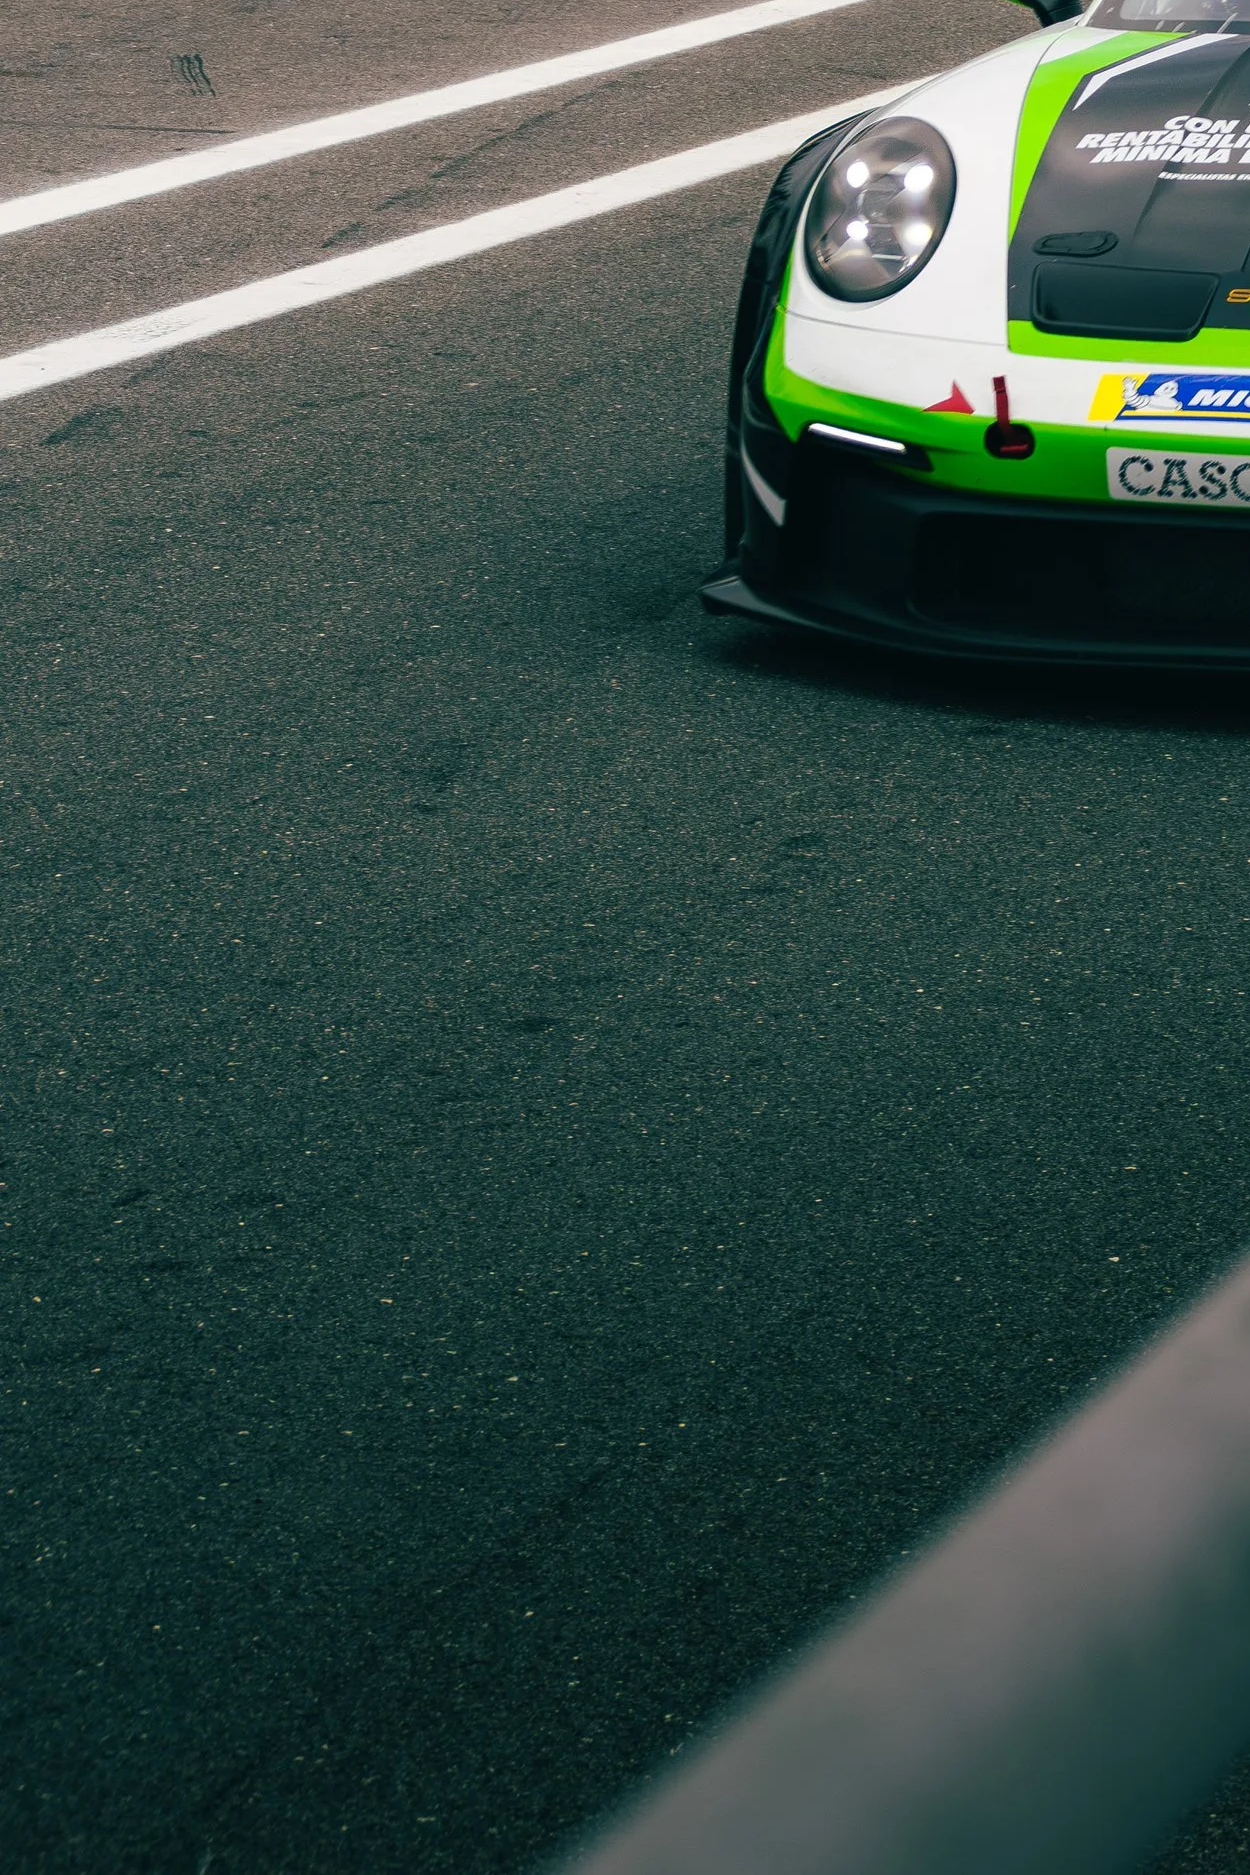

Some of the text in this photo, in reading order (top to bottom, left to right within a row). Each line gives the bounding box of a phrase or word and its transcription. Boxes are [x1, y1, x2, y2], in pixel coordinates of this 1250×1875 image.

[1164, 115, 1240, 134] CON
[1089, 146, 1233, 165] MINIMA
[1157, 171, 1237, 181] ESPECIALISTAS
